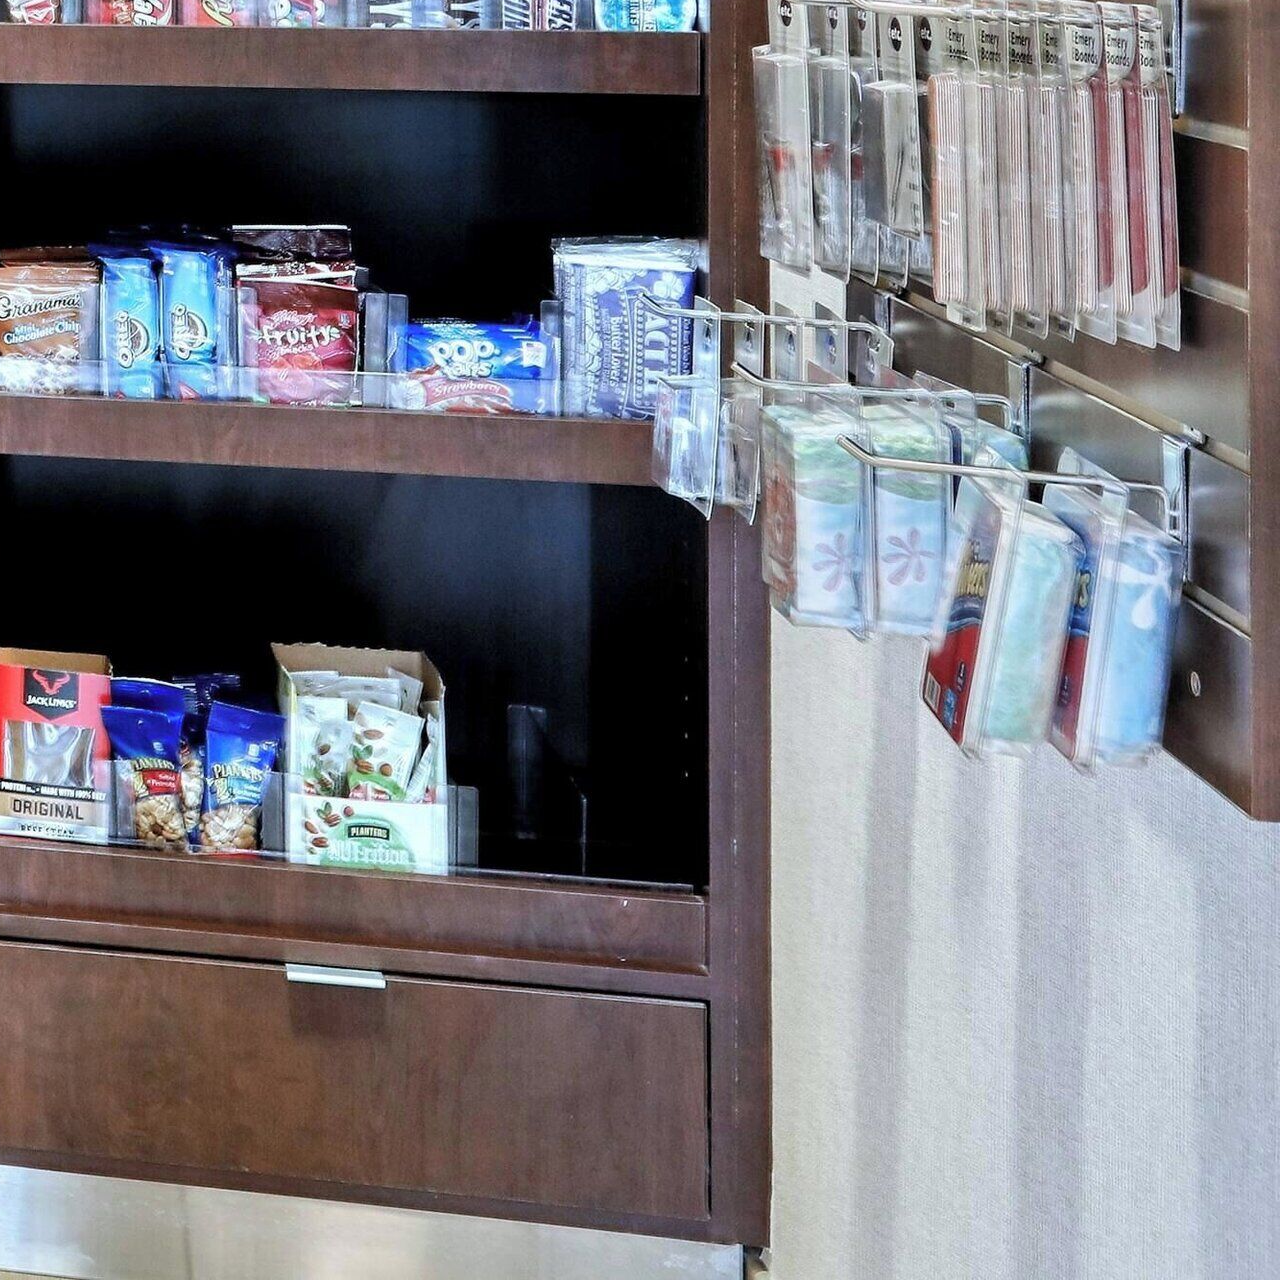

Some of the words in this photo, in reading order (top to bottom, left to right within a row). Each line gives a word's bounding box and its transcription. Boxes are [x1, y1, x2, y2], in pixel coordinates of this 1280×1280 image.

[948, 29, 965, 45] Emery
[981, 30, 1000, 49] Emery
[1010, 31, 1032, 51] Emery
[1075, 32, 1096, 51] Emery
[1106, 33, 1129, 52] Emery
[981, 49, 1002, 63] Boards
[1010, 50, 1033, 65] Boards
[1074, 49, 1098, 66] Boards
[3, 328, 55, 345] Chocolate
[14, 324, 36, 336] Mini
[172, 302, 192, 361] OREO
[115, 309, 134, 369] OREO
[433, 381, 502, 398] Strawberry
[26, 694, 48, 707] JACK
[40, 786, 59, 797] MADE
[59, 787, 76, 798] WITH
[75, 789, 92, 800] 100%
[12, 799, 85, 821] ORIGINAL
[350, 826, 388, 839] PLANTERS
